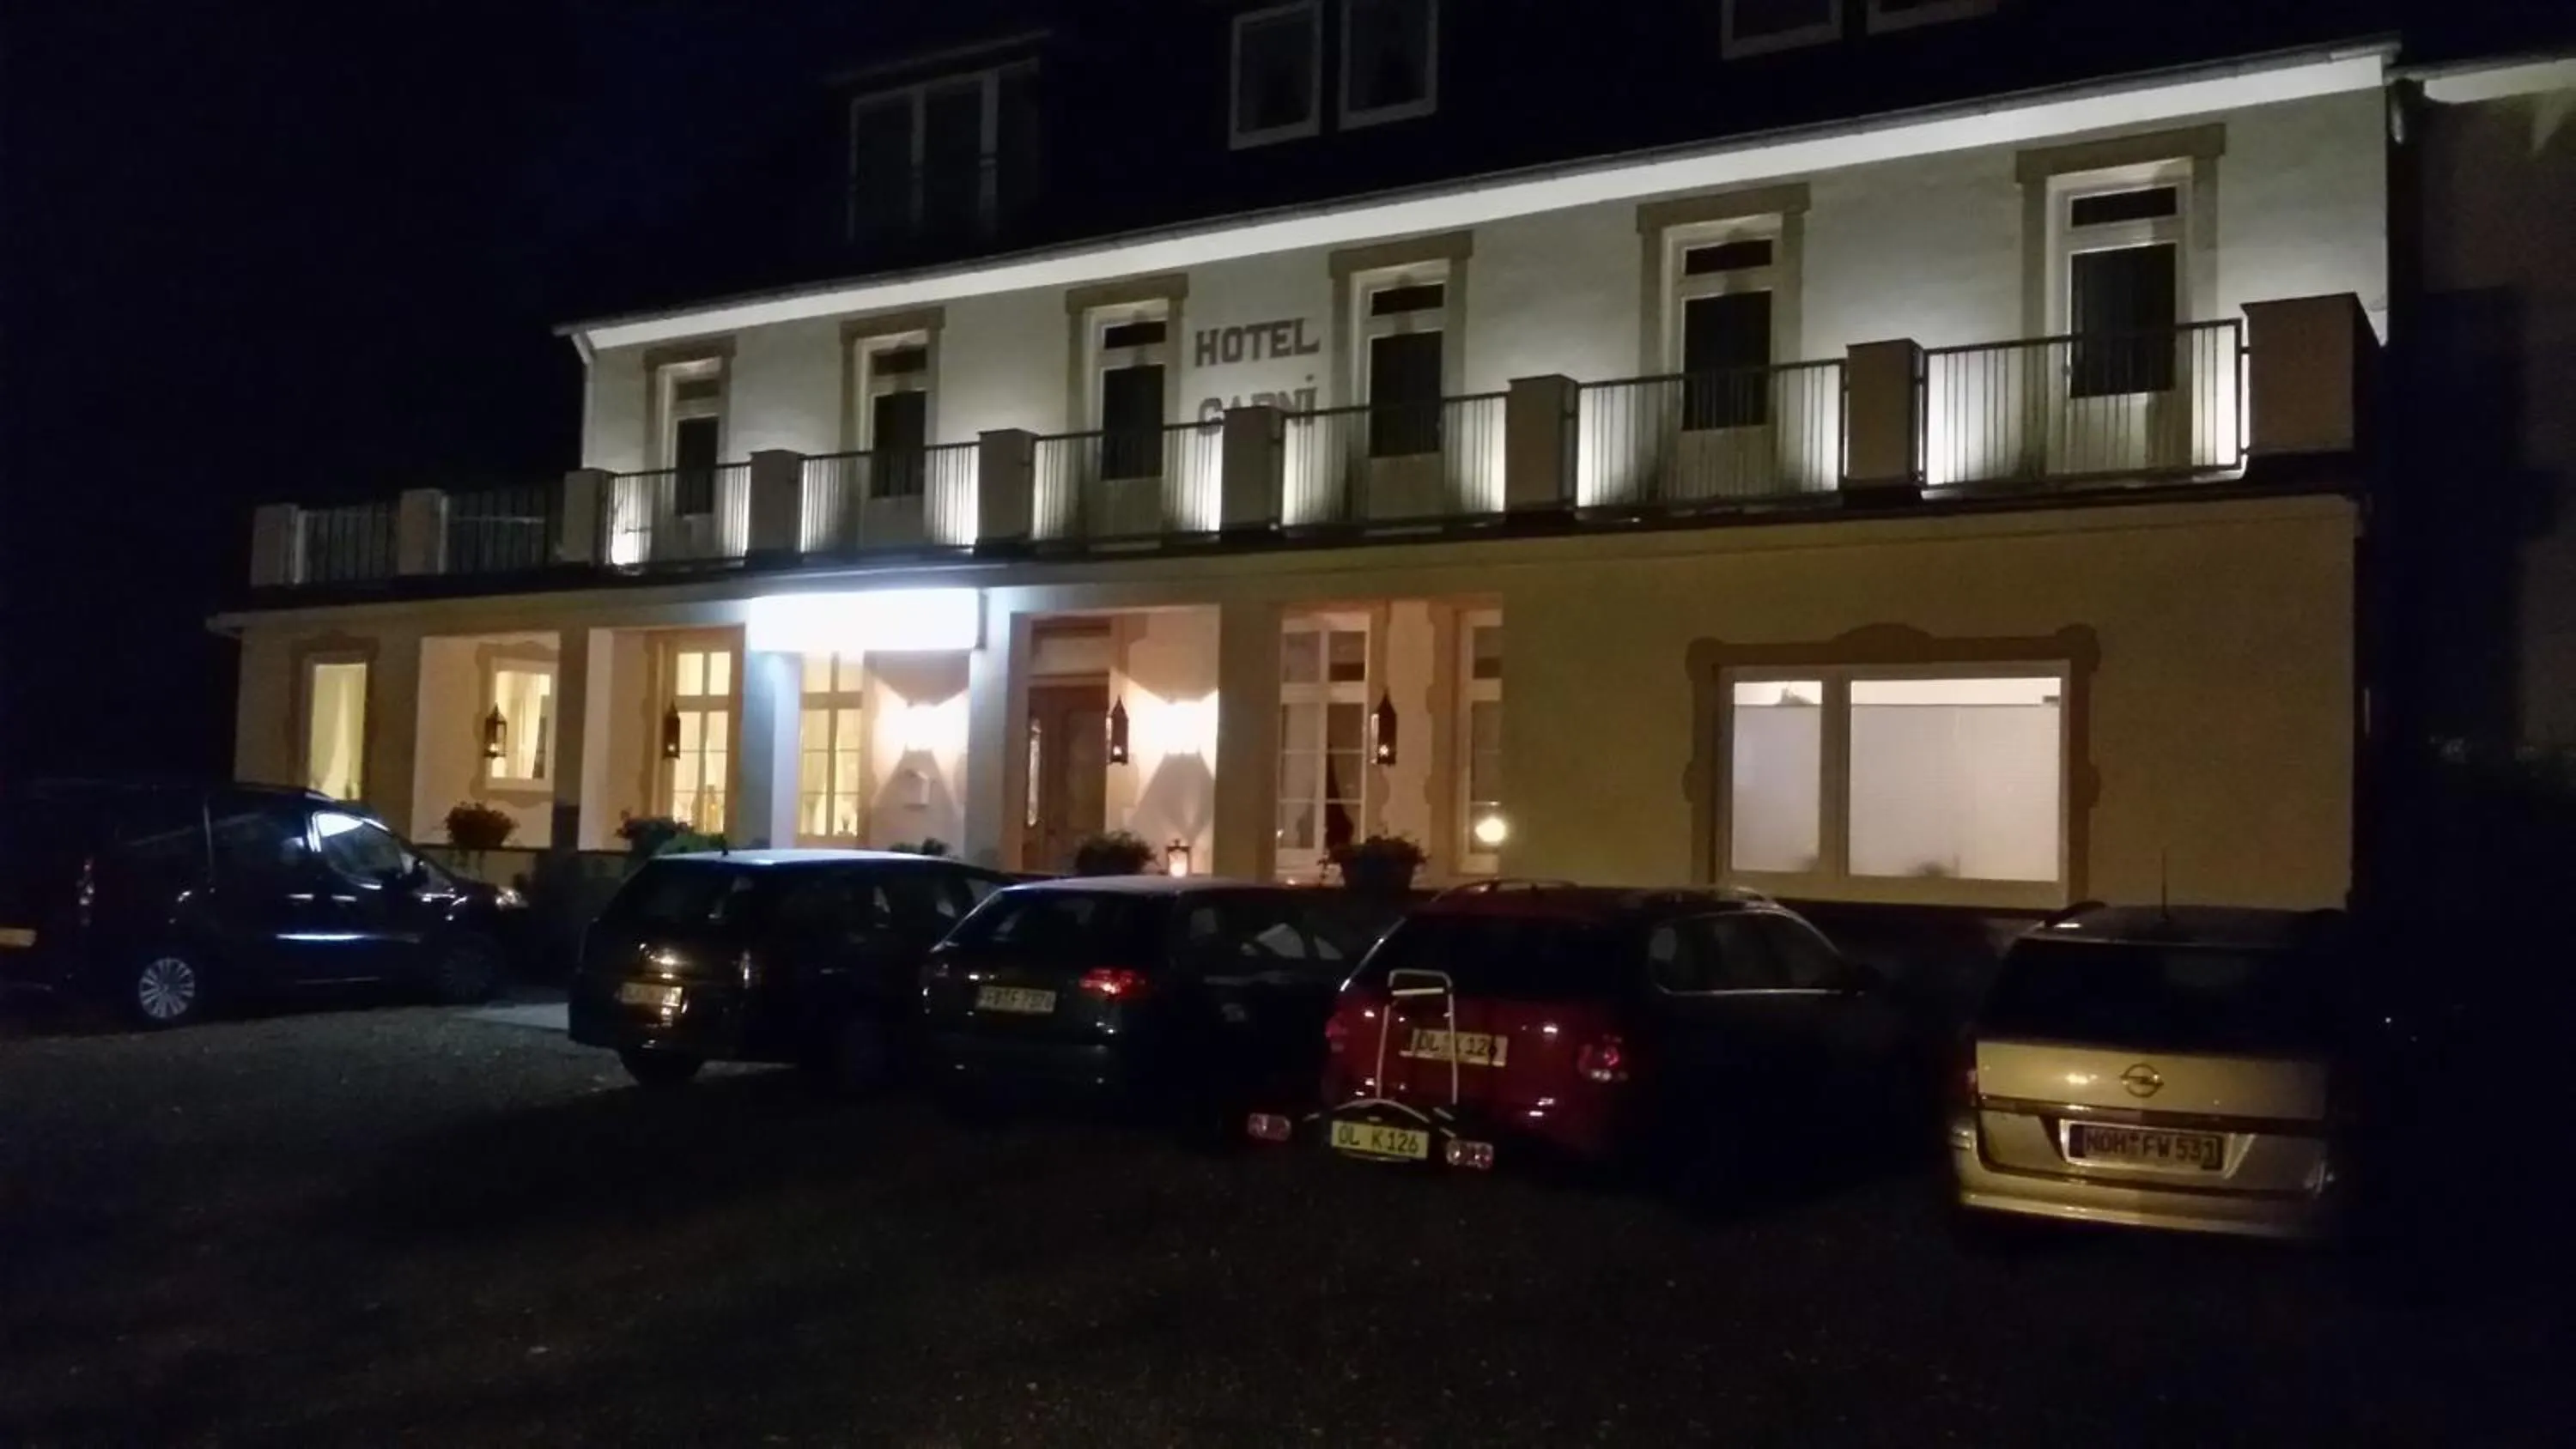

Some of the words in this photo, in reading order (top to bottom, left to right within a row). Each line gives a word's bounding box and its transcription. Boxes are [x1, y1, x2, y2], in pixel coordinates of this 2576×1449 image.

[1195, 318, 1320, 367] HOTEL
[1338, 1125, 1360, 1145] OL
[1370, 1130, 1383, 1149] K
[1388, 1131, 1419, 1153] 126
[2142, 1135, 2170, 1158] FW
[2175, 1136, 2215, 1163] 531
